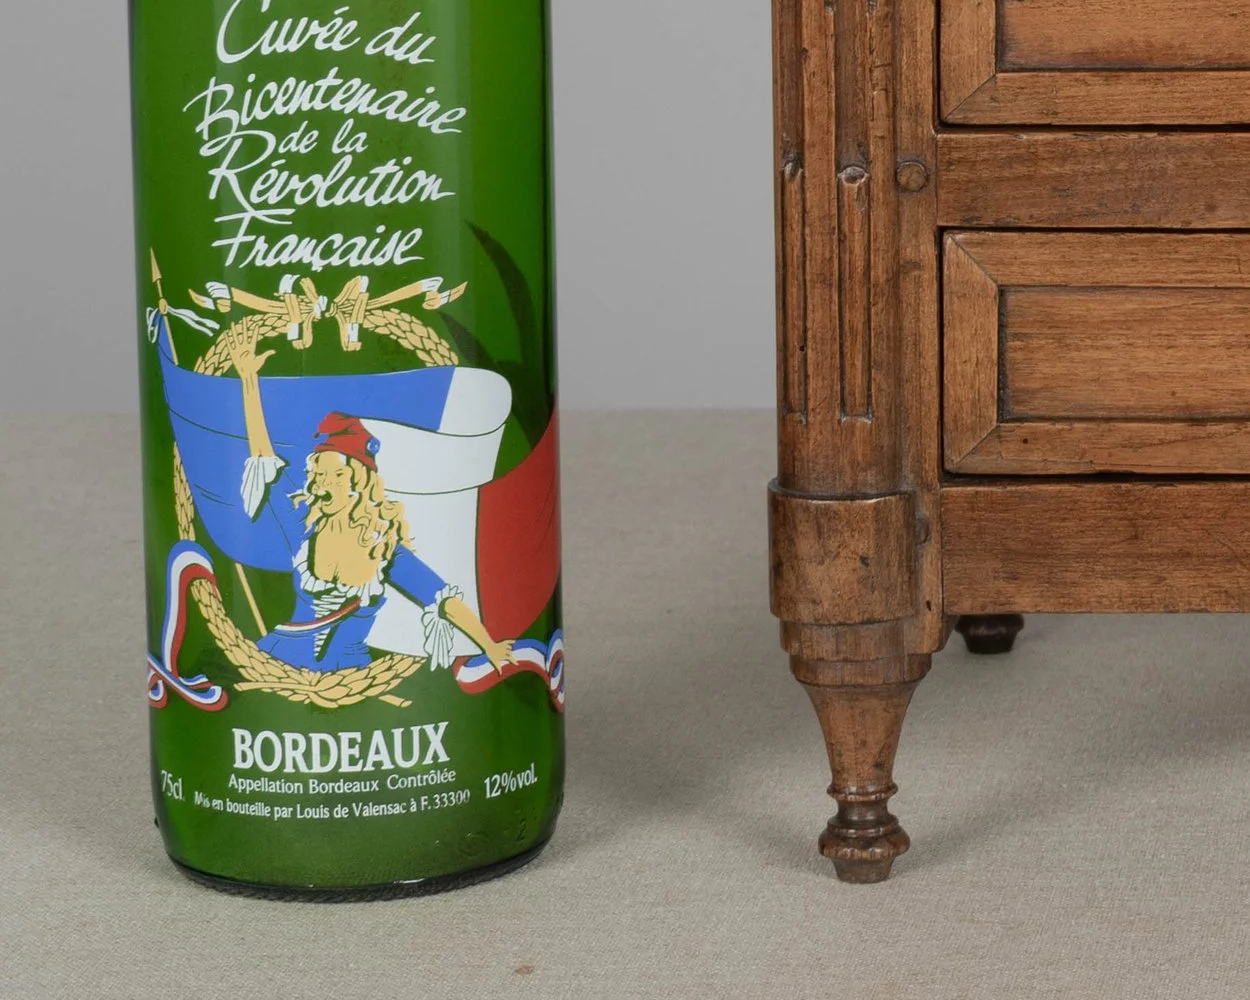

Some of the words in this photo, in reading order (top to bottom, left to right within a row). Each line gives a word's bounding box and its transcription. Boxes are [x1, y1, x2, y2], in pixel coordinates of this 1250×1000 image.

[365, 11, 437, 64] du
[183, 66, 468, 157] Bicentenaire
[278, 120, 319, 155] de
[332, 118, 369, 154] la
[208, 129, 456, 225] Révolution
[211, 207, 425, 272] Française
[232, 721, 450, 774] BORDEAUX
[194, 791, 211, 809] Mis
[211, 798, 224, 811] en
[226, 798, 271, 817] bouteille
[274, 805, 293, 821] par
[296, 803, 330, 819] Louis
[333, 804, 350, 818] de
[352, 801, 407, 817] Valensac
[409, 798, 417, 813] à
[228, 773, 303, 795] Appellation
[308, 778, 379, 794] Bordeaux
[386, 769, 457, 790] Contrôlée
